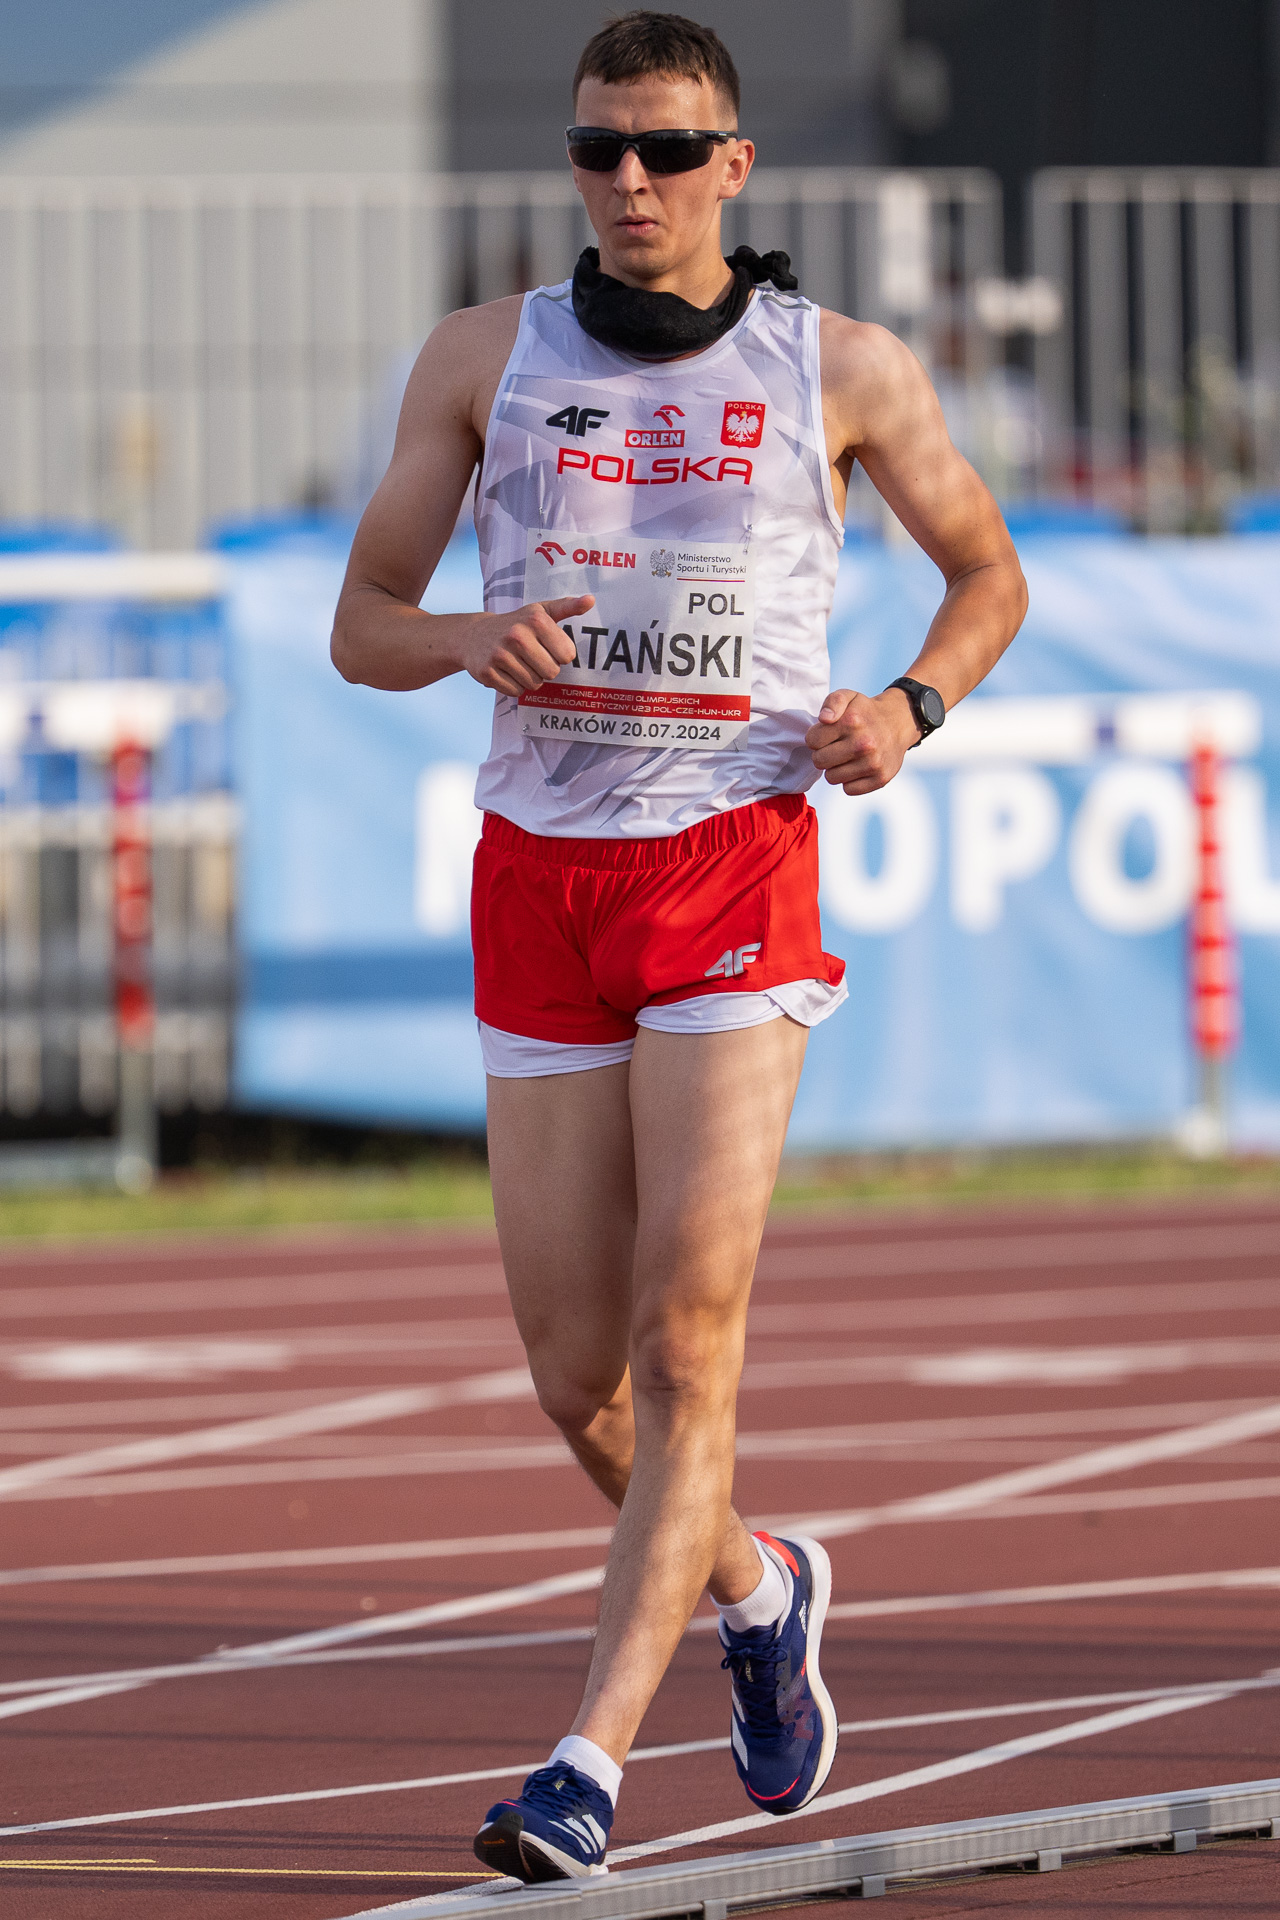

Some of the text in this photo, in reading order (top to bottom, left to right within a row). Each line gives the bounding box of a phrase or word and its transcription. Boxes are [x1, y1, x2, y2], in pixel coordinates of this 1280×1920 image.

[727, 403, 763, 411] POLSKA
[545, 405, 611, 437] 4F
[627, 432, 682, 446] ORLEN
[557, 447, 753, 485] POLSKA
[572, 548, 637, 569] ORLEN
[676, 563, 704, 575] Sportu
[712, 565, 747, 575] Turystyki
[677, 552, 732, 564] Ministerstwo
[688, 592, 745, 616] POL
[524, 694, 742, 717] MECZ LEKKOATLETYCZNY U23 POL-CZE-HUN-UKR
[561, 688, 700, 705] TURNIEJ NADZIEI OLIMPIJSKICH
[539, 713, 721, 741] KRAKÓW 20.07.2024
[704, 942, 762, 978] 4F
